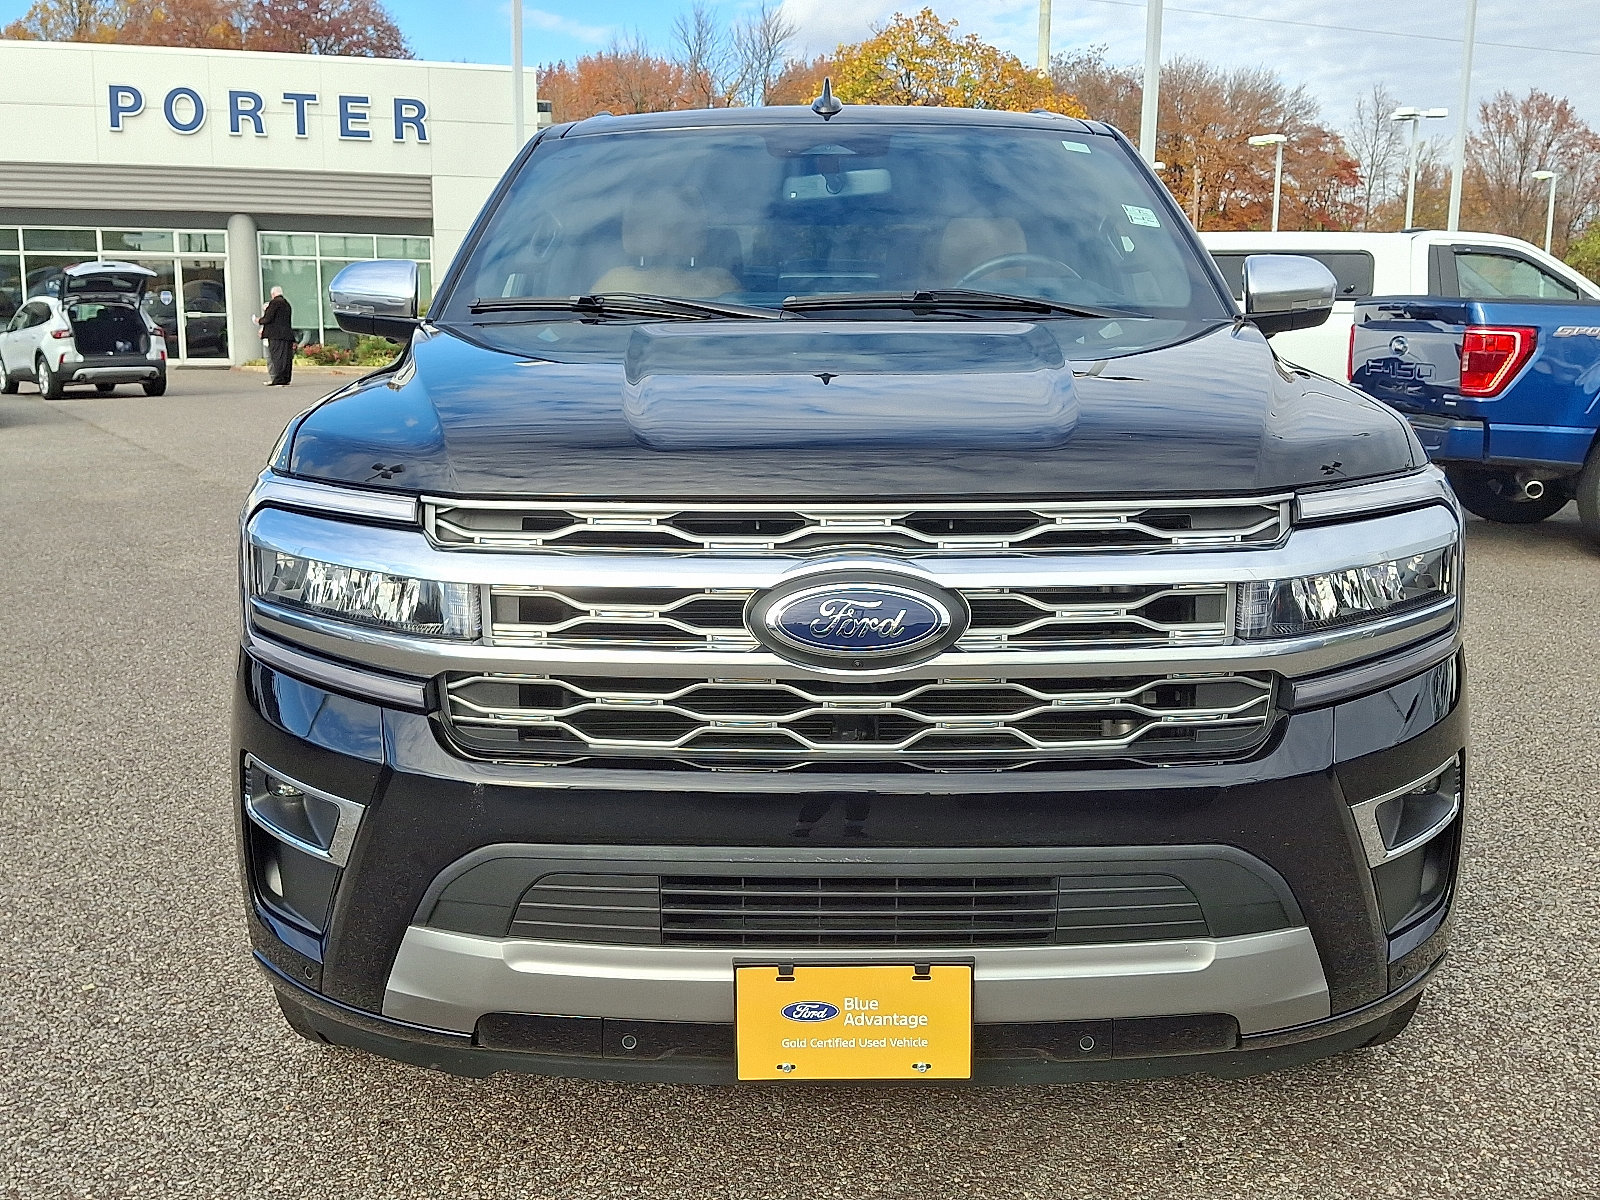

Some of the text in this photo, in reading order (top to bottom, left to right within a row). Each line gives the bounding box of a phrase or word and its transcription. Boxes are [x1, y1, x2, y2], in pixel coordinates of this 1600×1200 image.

[107, 83, 431, 144] PORTER
[1365, 359, 1436, 381] F-150
[810, 598, 907, 638] Ford
[792, 1004, 828, 1019] Ford
[843, 997, 879, 1011] Blue
[843, 1013, 928, 1029] Advantage
[781, 1037, 929, 1048] Gold Certified Used Vehicle
